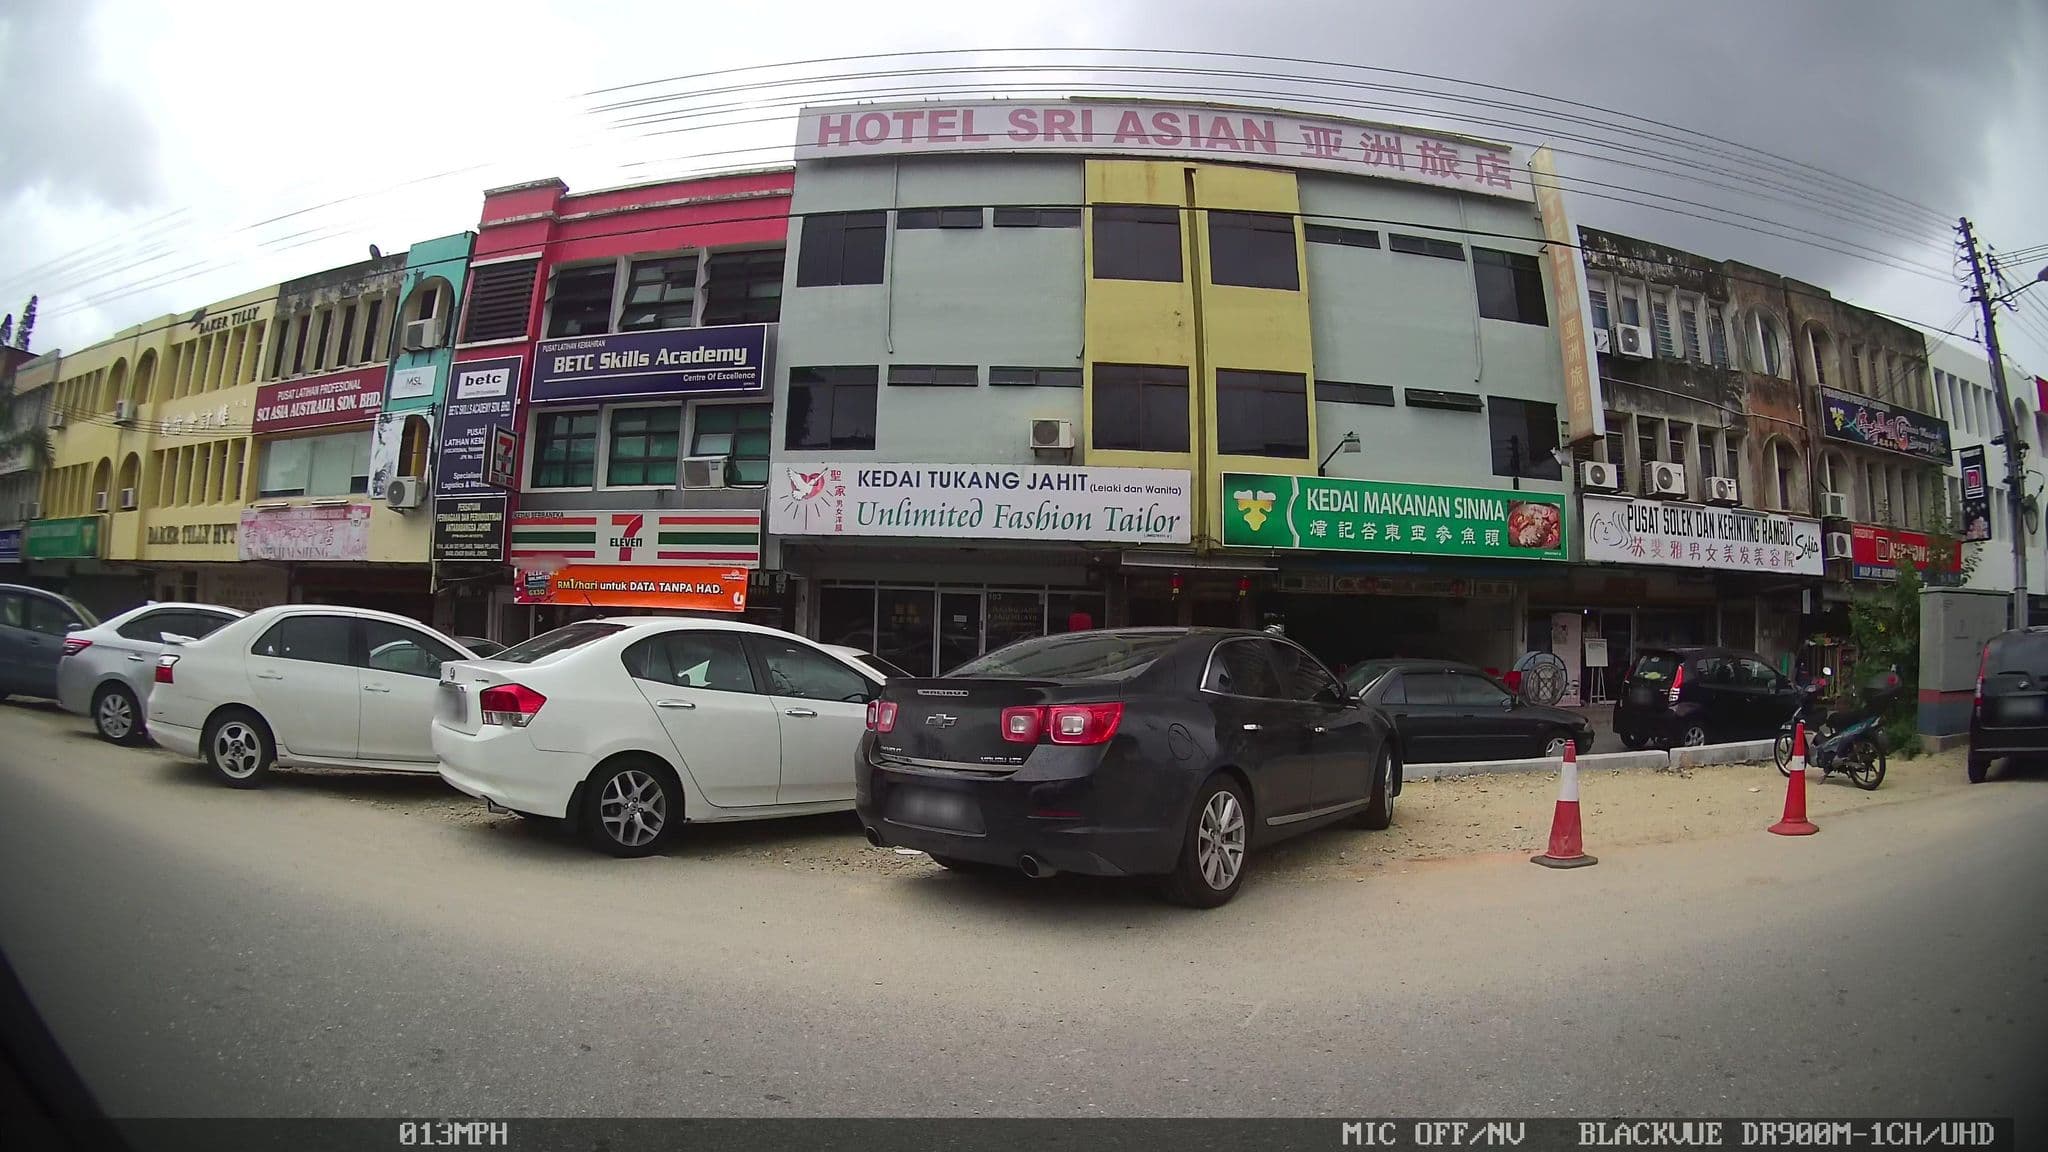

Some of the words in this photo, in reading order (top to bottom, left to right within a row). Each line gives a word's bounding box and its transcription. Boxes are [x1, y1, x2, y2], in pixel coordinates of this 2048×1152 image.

[817, 108, 990, 148] HOTEL
[1008, 108, 1092, 143] SRI
[1113, 110, 1278, 154] ASIAN
[1300, 123, 1513, 190] 亚洲旅店
[199, 315, 228, 335] BAKER
[231, 306, 260, 326] TILLY
[553, 353, 595, 374] BETC
[600, 349, 650, 370] Skills
[655, 346, 748, 366] Academy
[1563, 317, 1586, 412] 亚洲旅店
[465, 373, 502, 386] betc
[683, 373, 706, 382] Centre
[707, 372, 716, 381] Of
[717, 371, 756, 380] Excellence
[277, 389, 296, 401] PUSAT
[289, 397, 335, 417] AUSTRALIA
[336, 394, 357, 411] SDN.
[359, 391, 382, 408] BHD.
[444, 437, 470, 447] LATIHAN
[858, 470, 920, 488] KEDAI
[928, 471, 1020, 490] TUKANG
[1027, 473, 1088, 492] JAHIT
[1123, 485, 1143, 494] dan
[1145, 485, 1182, 496] Wanita)
[857, 496, 984, 528] Unlimited
[992, 500, 1092, 531] Fashion
[1103, 502, 1181, 534] Tailor
[1307, 488, 1359, 513] KEDAI
[1364, 491, 1451, 518] MAKANAN
[1454, 496, 1505, 521] SINMA
[612, 514, 643, 562] 7
[1627, 504, 1659, 534] PUSAT
[1663, 507, 1693, 537] SOLEK
[1696, 511, 1715, 539] DAN
[1717, 513, 1760, 543] KERINTING
[1762, 518, 1794, 546] RAMBUT
[557, 578, 598, 590] RM1/hari
[600, 582, 627, 591] untuk
[630, 581, 656, 592] DATA
[659, 582, 693, 593] TANPA
[696, 583, 724, 594] HAD.
